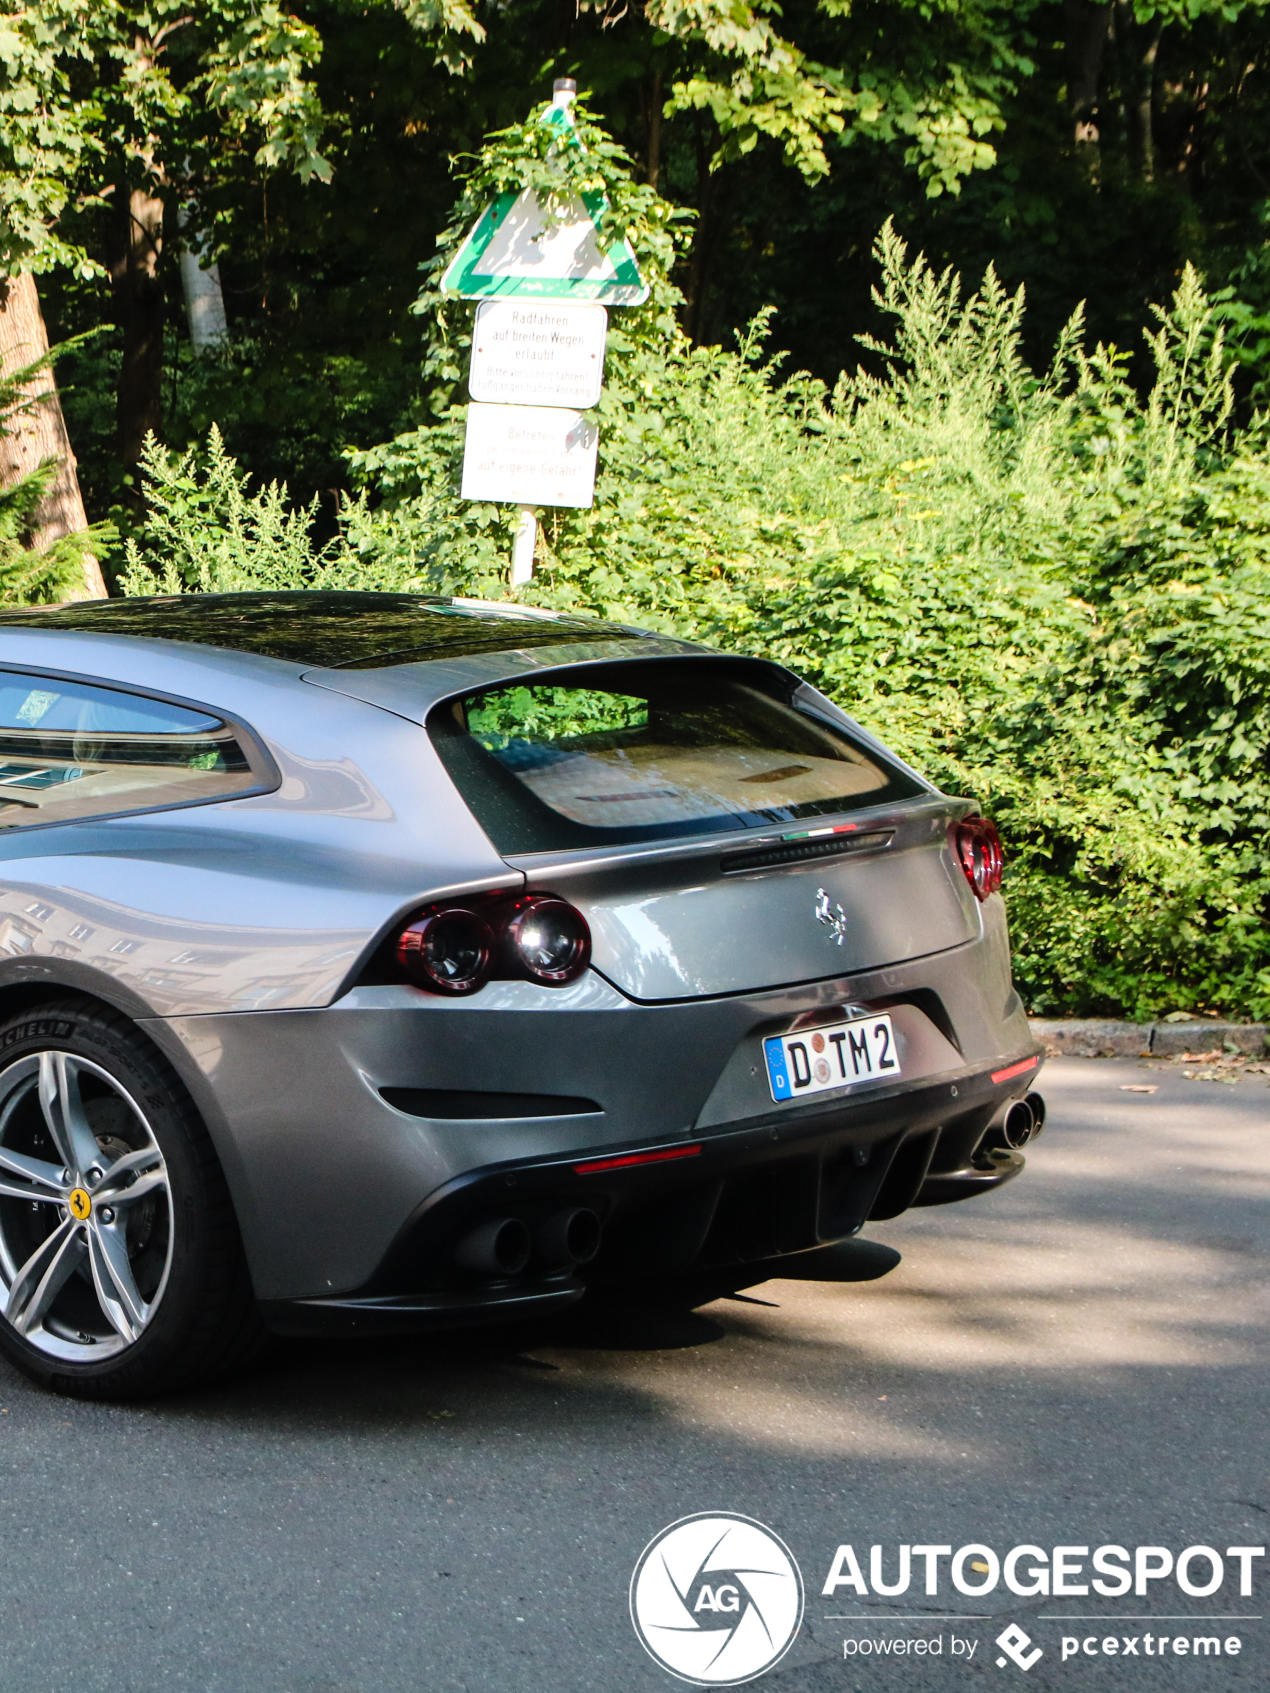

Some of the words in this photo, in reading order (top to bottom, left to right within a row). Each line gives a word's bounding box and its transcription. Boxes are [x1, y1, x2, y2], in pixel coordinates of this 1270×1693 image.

[512, 310, 569, 327] Radfahren
[492, 329, 509, 341] auf
[512, 330, 547, 343] breiten
[550, 331, 584, 348] Wegen
[515, 348, 554, 361] erlaubt
[486, 366, 507, 377] Bitte
[508, 427, 555, 442] Betreten
[477, 460, 495, 471] auf
[499, 463, 536, 476] eigene
[787, 1042, 811, 1088] D
[828, 1028, 872, 1078] TM
[874, 1023, 895, 1069] 2
[776, 1075, 784, 1088] D
